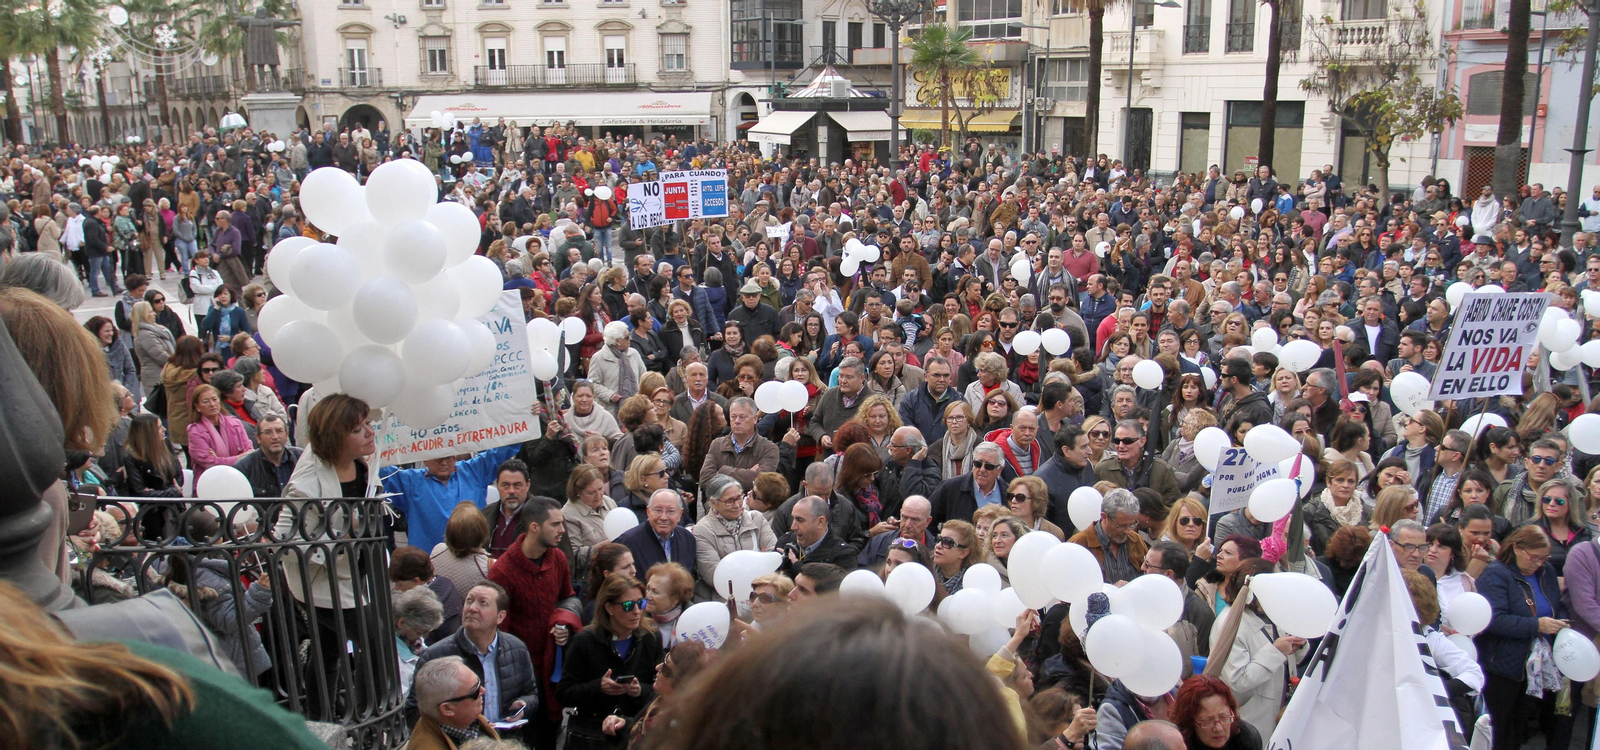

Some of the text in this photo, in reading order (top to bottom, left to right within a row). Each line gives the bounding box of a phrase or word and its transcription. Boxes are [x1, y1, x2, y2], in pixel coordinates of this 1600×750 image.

[661, 170, 726, 182] ¿PARA CUANDO?
[643, 182, 660, 197] NO
[664, 186, 686, 195] JUNTA
[704, 198, 724, 207] ACCESOS
[631, 216, 636, 229] A
[638, 213, 648, 228] LOS
[1490, 298, 1518, 322] CHARE
[1516, 297, 1547, 321] COSTA!
[1457, 328, 1518, 346] NOS VA
[1445, 346, 1523, 374] LA VIDA
[1438, 374, 1510, 395] EN ELLO
[472, 396, 482, 405] de
[483, 395, 492, 403] la
[410, 423, 463, 439] 40 años.
[410, 437, 443, 453] ACUDIR
[447, 439, 454, 448] a
[457, 420, 528, 445] EXTREMADURA
[1256, 467, 1277, 482] DIGNA
